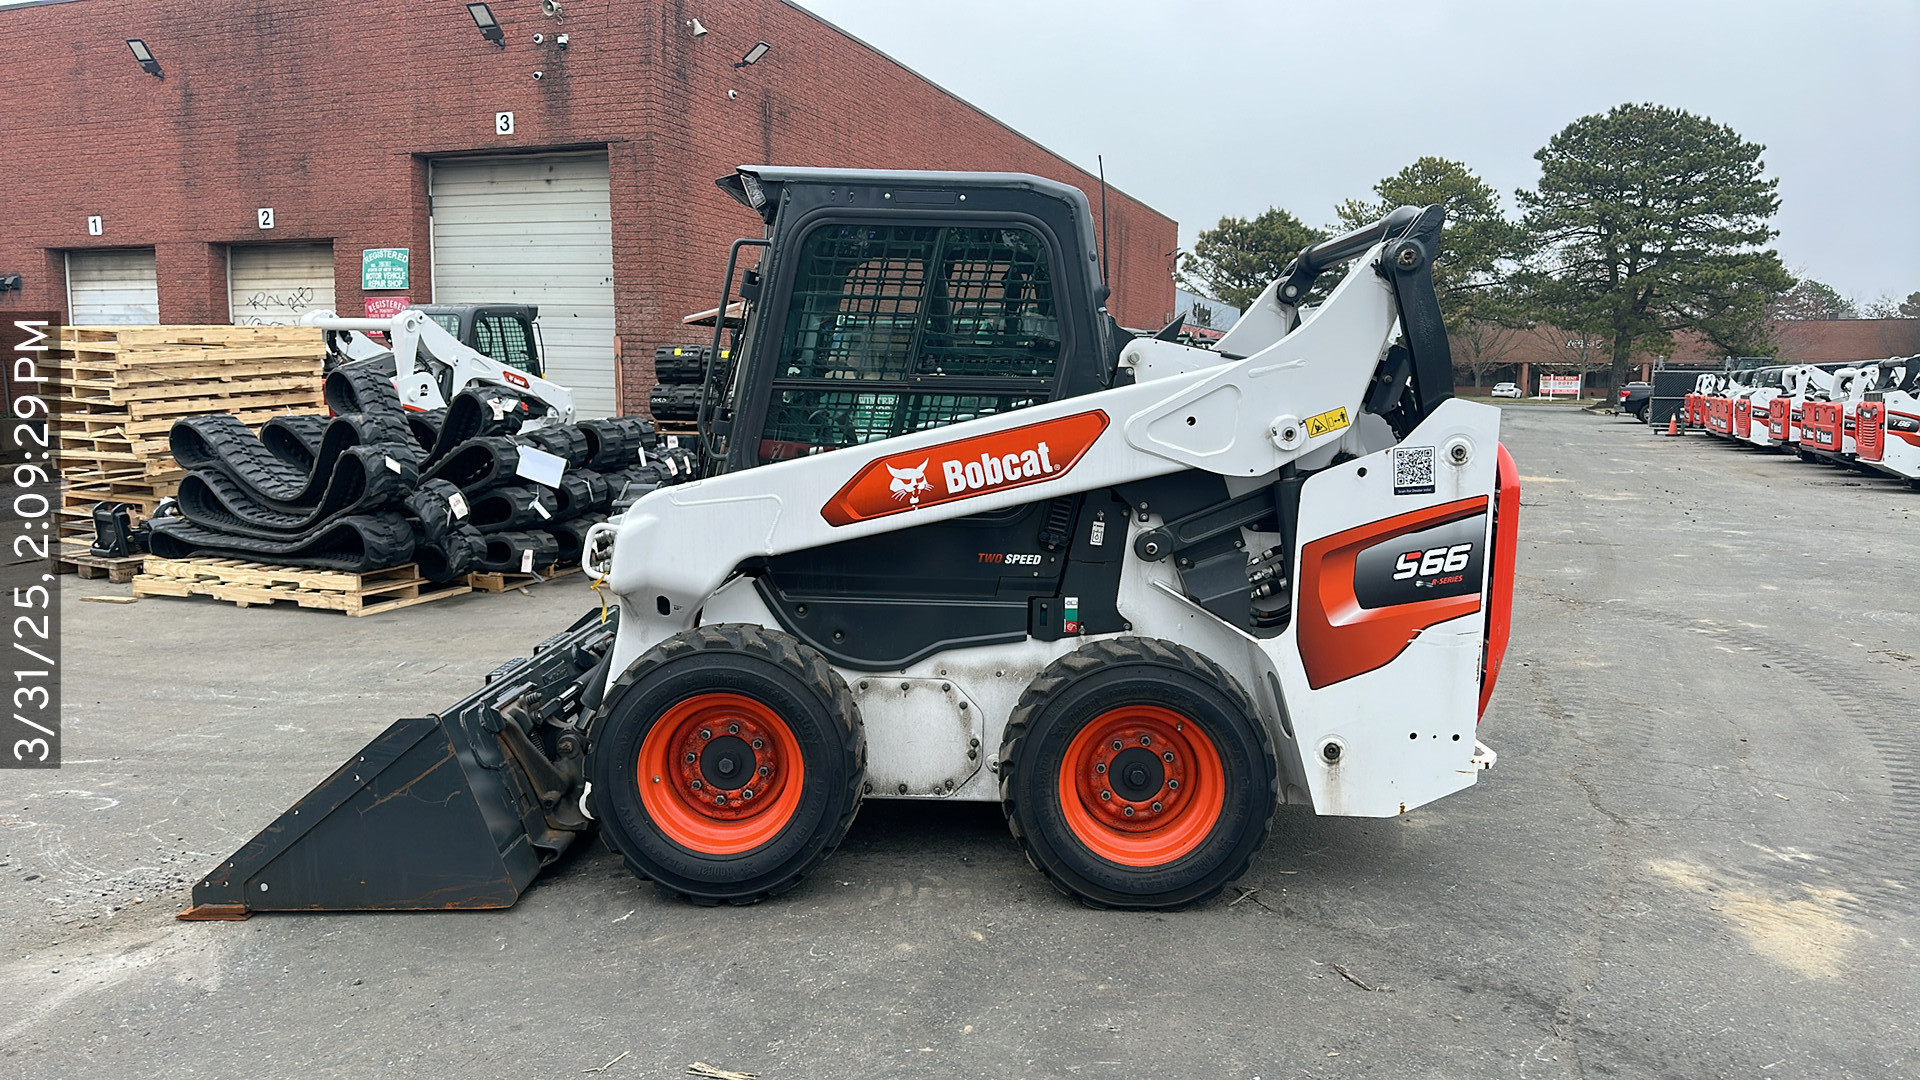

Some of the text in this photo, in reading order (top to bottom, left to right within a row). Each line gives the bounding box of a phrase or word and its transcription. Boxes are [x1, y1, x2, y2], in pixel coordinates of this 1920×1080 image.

[499, 114, 510, 132] 3
[91, 218, 98, 233] 1
[261, 211, 271, 226] 2
[364, 250, 409, 264] REGISTERED
[383, 271, 406, 280] VEHICLE
[368, 280, 403, 288] REPAIR SHOP
[942, 441, 1053, 495] Bobcat
[977, 553, 1042, 565] TWO SPEED
[1393, 543, 1472, 581] S66
